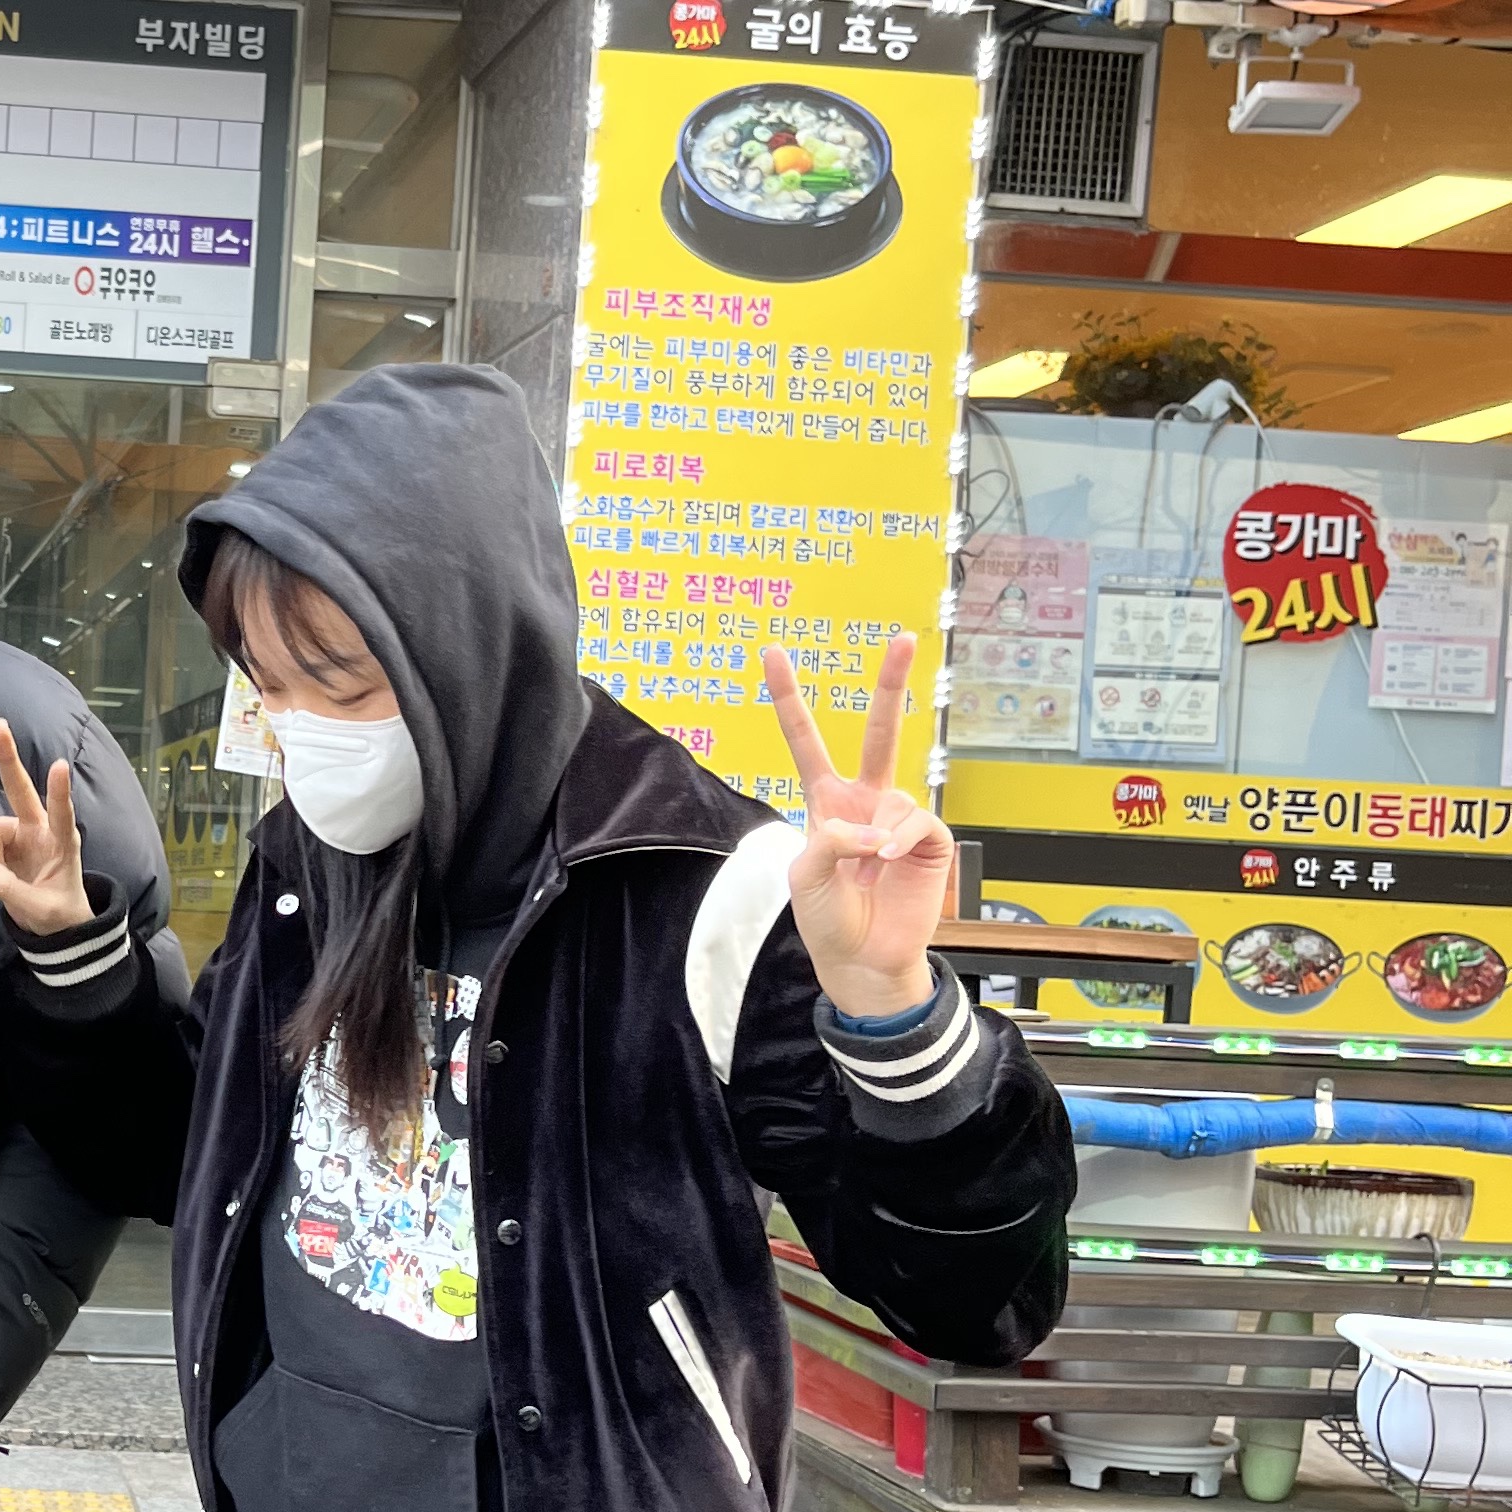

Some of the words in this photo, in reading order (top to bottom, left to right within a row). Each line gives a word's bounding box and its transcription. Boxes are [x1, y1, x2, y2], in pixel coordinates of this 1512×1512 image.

[674, 2, 717, 22] 콩가마
[136, 18, 266, 60] 부자빌딩
[672, 22, 720, 50] 24시
[746, 8, 822, 54] 굴의
[839, 14, 918, 61] 효능
[128, 232, 180, 258] 24시
[28, 272, 53, 284] Salad
[55, 272, 70, 286] Bar
[605, 287, 772, 326] 피부조직재생
[50, 320, 113, 344] 골든노래방
[146, 326, 234, 350] 디온스크린골프
[588, 332, 654, 360] 굴에는
[664, 338, 776, 368] 피부미용에
[788, 346, 832, 372] 좋은
[844, 350, 932, 378] 비타민과
[584, 364, 672, 393] 무기질이
[686, 370, 774, 399] 풍부하게
[788, 376, 874, 406] 함유되어
[888, 383, 928, 410] 있어
[583, 400, 641, 427] 피부를
[650, 403, 708, 430] 환하고
[717, 408, 794, 436] 탄력있게
[803, 413, 860, 441] 만들어
[868, 418, 930, 446] 줍니다.
[594, 452, 704, 484] 피로회복
[578, 495, 674, 524] 소화흡수가
[683, 500, 740, 527] 잘되며
[750, 504, 807, 532] 칼로리
[816, 508, 873, 536] 전환이
[882, 512, 939, 540] 빨라서
[574, 526, 633, 552] 피로를
[641, 530, 700, 556] 빠르게
[708, 533, 786, 562] 회복시켜
[794, 538, 856, 566] 줍니다.
[1232, 510, 1362, 560] 콩가마
[588, 569, 668, 600] 심혈관
[684, 574, 792, 608] 질환예방
[1230, 562, 1379, 646] 24시
[622, 607, 705, 636] 함유되어
[718, 612, 758, 638] 있는
[769, 616, 830, 643] 타우린
[685, 642, 746, 670] 생성을
[640, 675, 744, 704] 낮추어주는
[1115, 782, 1158, 802] 콩가마
[1115, 803, 1164, 830] 24시
[1183, 794, 1230, 823] 옛날
[1243, 855, 1273, 869] 콩가마
[1243, 870, 1276, 888] 24시
